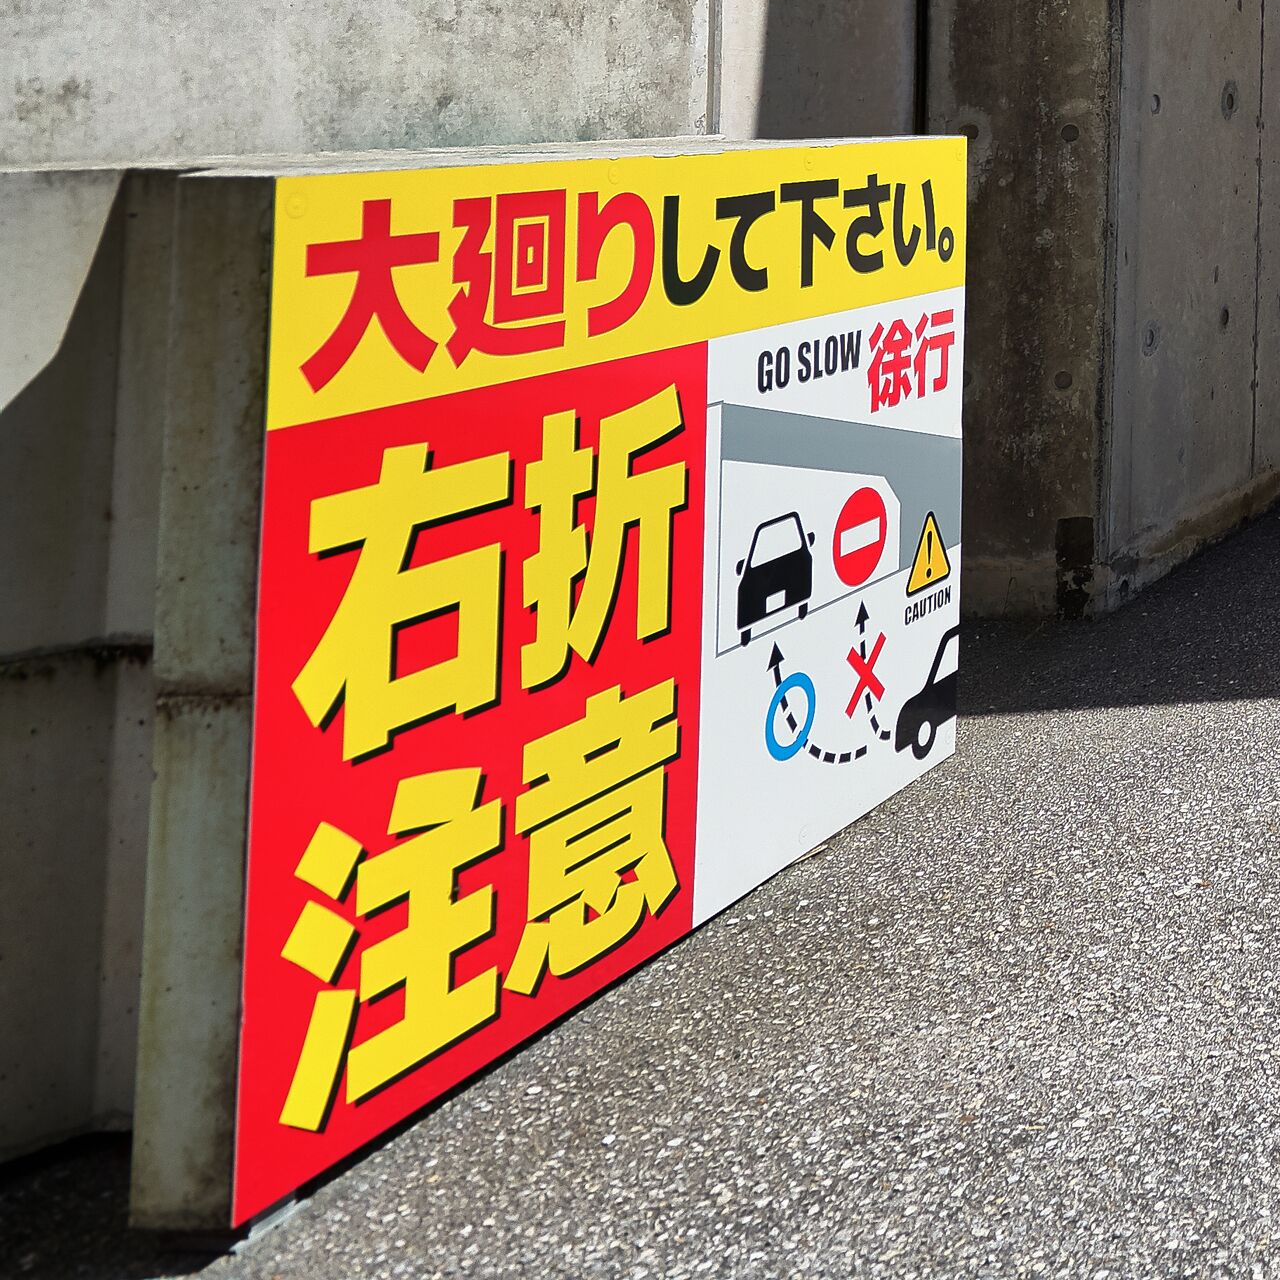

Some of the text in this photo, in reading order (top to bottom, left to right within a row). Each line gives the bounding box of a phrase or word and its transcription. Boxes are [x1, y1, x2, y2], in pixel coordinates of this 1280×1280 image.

[300, 174, 955, 394] 大廻りして下さい。
[757, 309, 955, 414] GO SLOW 徐行
[291, 382, 686, 762] 右折
[904, 585, 952, 625] CAUTION
[279, 676, 682, 1132] 注意
